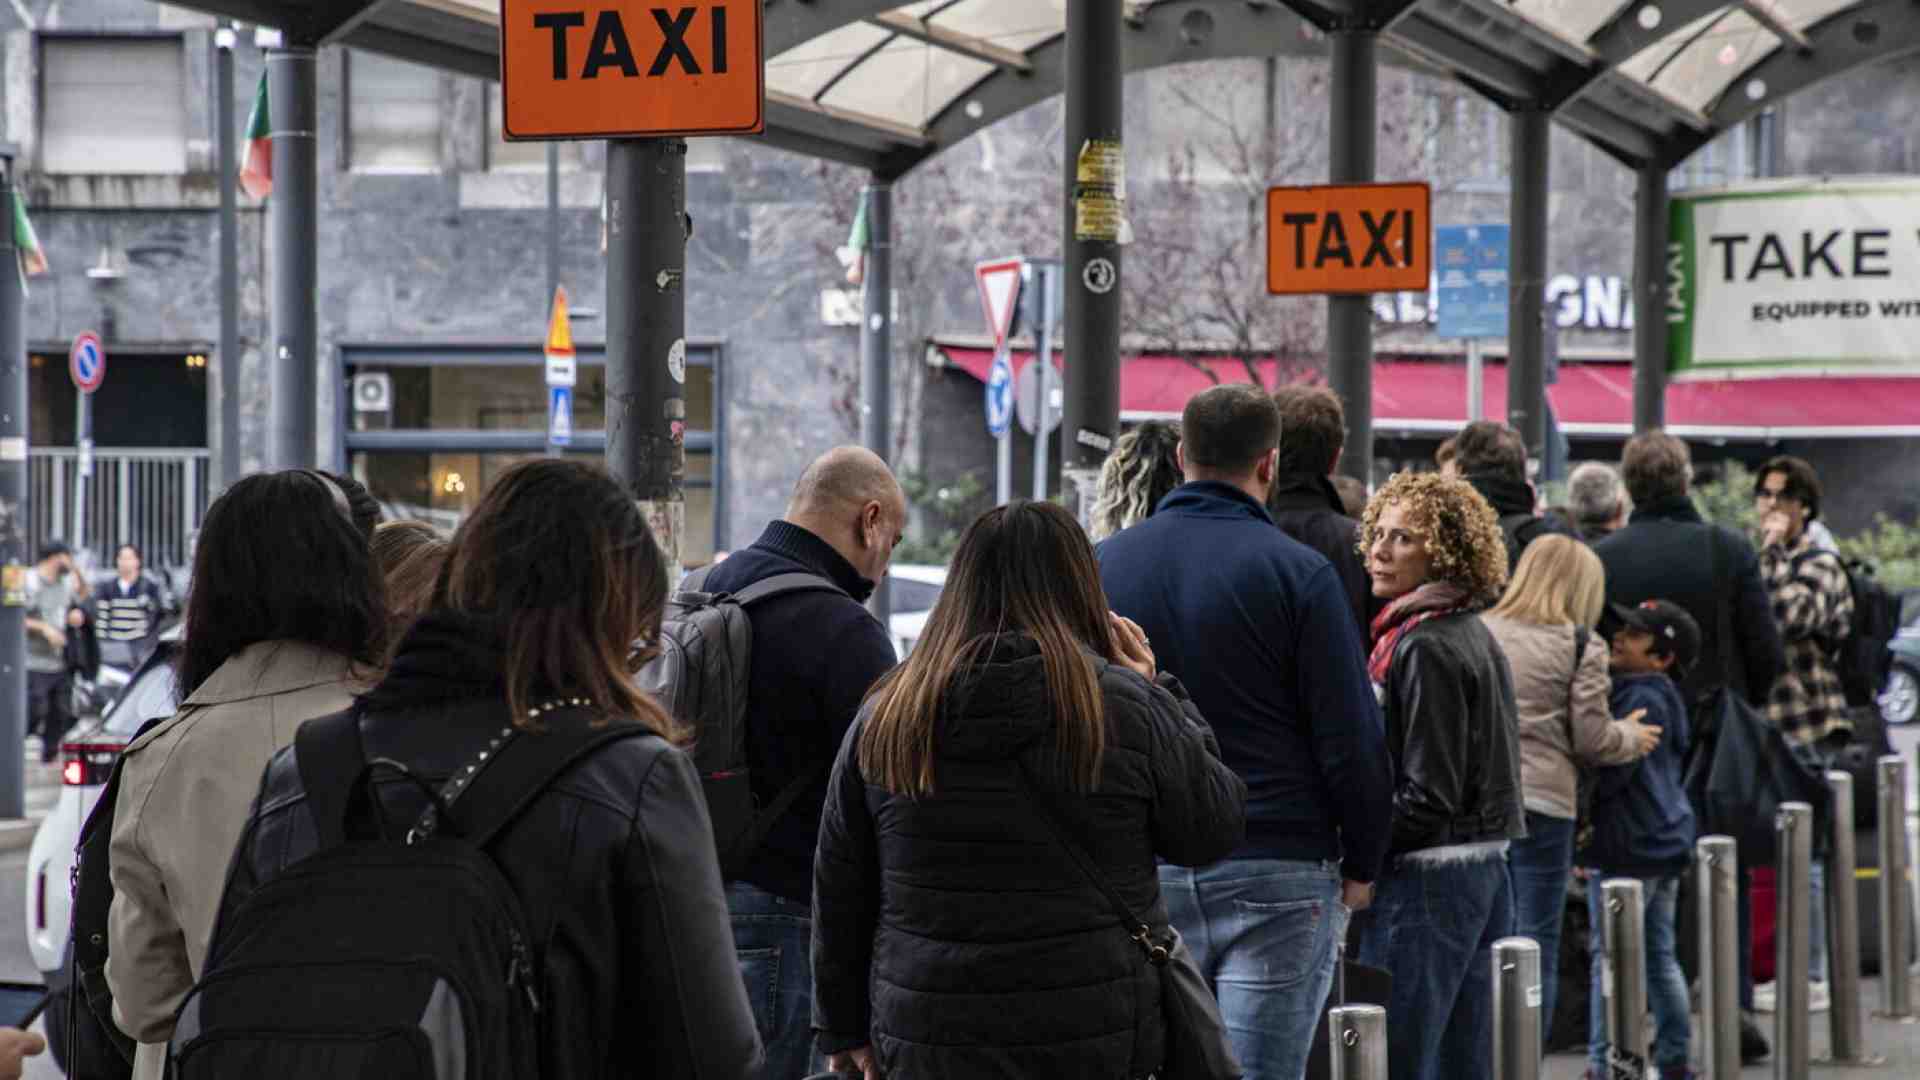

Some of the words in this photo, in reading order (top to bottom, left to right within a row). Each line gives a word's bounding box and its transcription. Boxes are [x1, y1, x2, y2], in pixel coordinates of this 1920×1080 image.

[533, 6, 728, 81] TAXI
[1282, 209, 1413, 269] TAXI
[1709, 228, 1891, 282] TAKE
[1751, 299, 1871, 323] EQUIPPED
